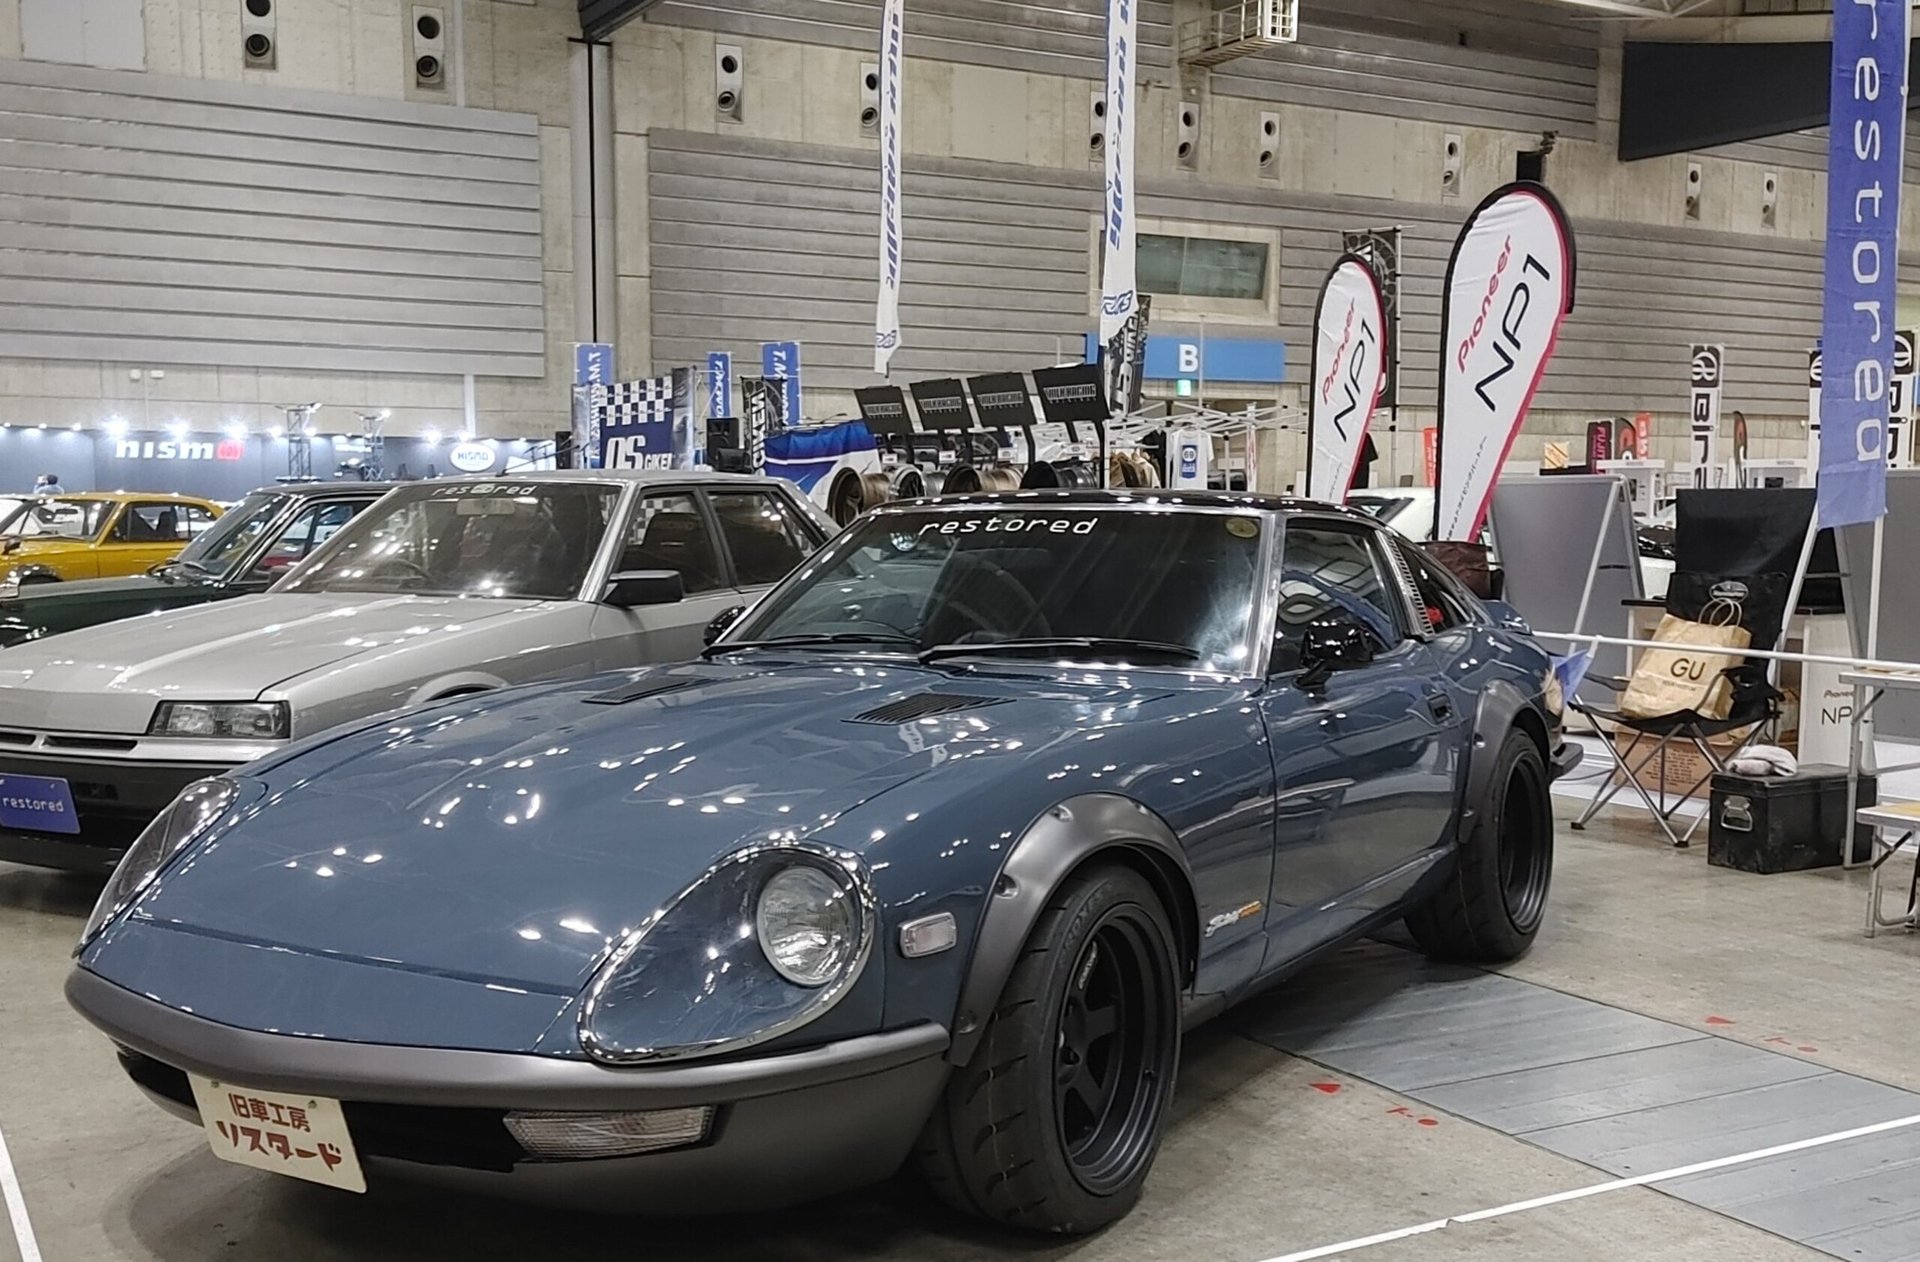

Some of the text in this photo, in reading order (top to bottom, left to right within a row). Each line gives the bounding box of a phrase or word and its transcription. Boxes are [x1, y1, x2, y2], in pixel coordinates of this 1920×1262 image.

[1457, 234, 1512, 375] Pioneer
[1321, 297, 1356, 406] Pioneer
[1474, 253, 1550, 412] NP1
[1179, 344, 1199, 372] B
[1333, 317, 1375, 442] NP1
[918, 517, 1099, 536] restored
[1670, 657, 1706, 681] GU
[2, 797, 65, 812] restored
[228, 1092, 311, 1133] 旧車工房
[216, 1120, 342, 1173] リスタード
